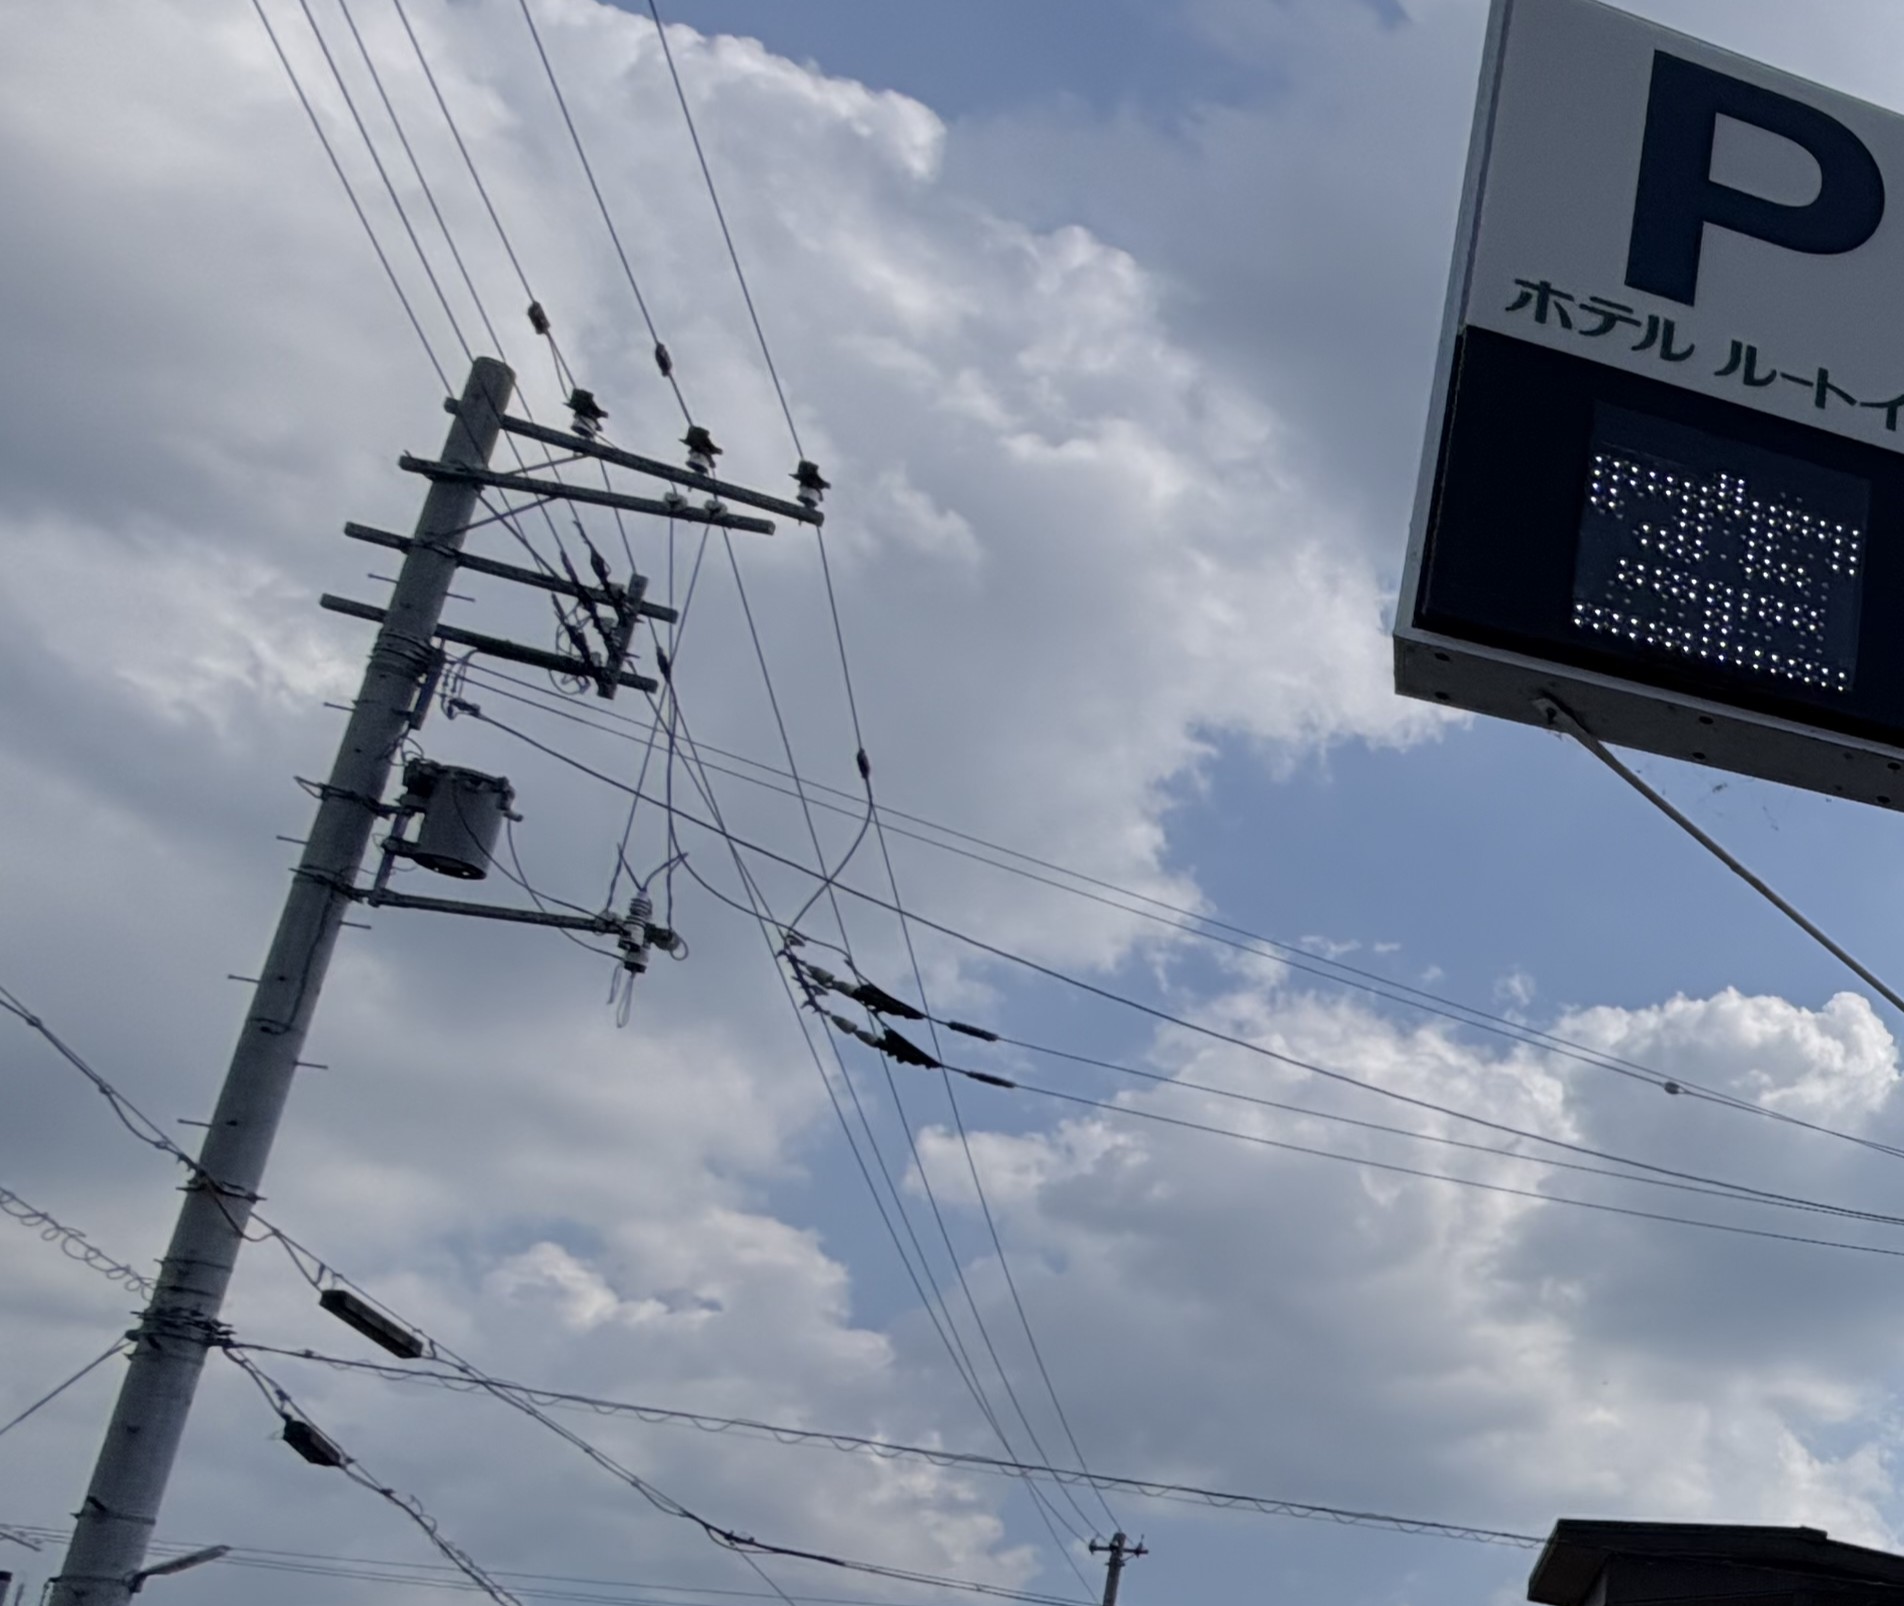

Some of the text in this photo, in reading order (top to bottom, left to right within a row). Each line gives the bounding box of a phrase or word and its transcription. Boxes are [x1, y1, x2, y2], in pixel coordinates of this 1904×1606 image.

[1624, 49, 1885, 307] P
[1505, 279, 1695, 362] ホテル
